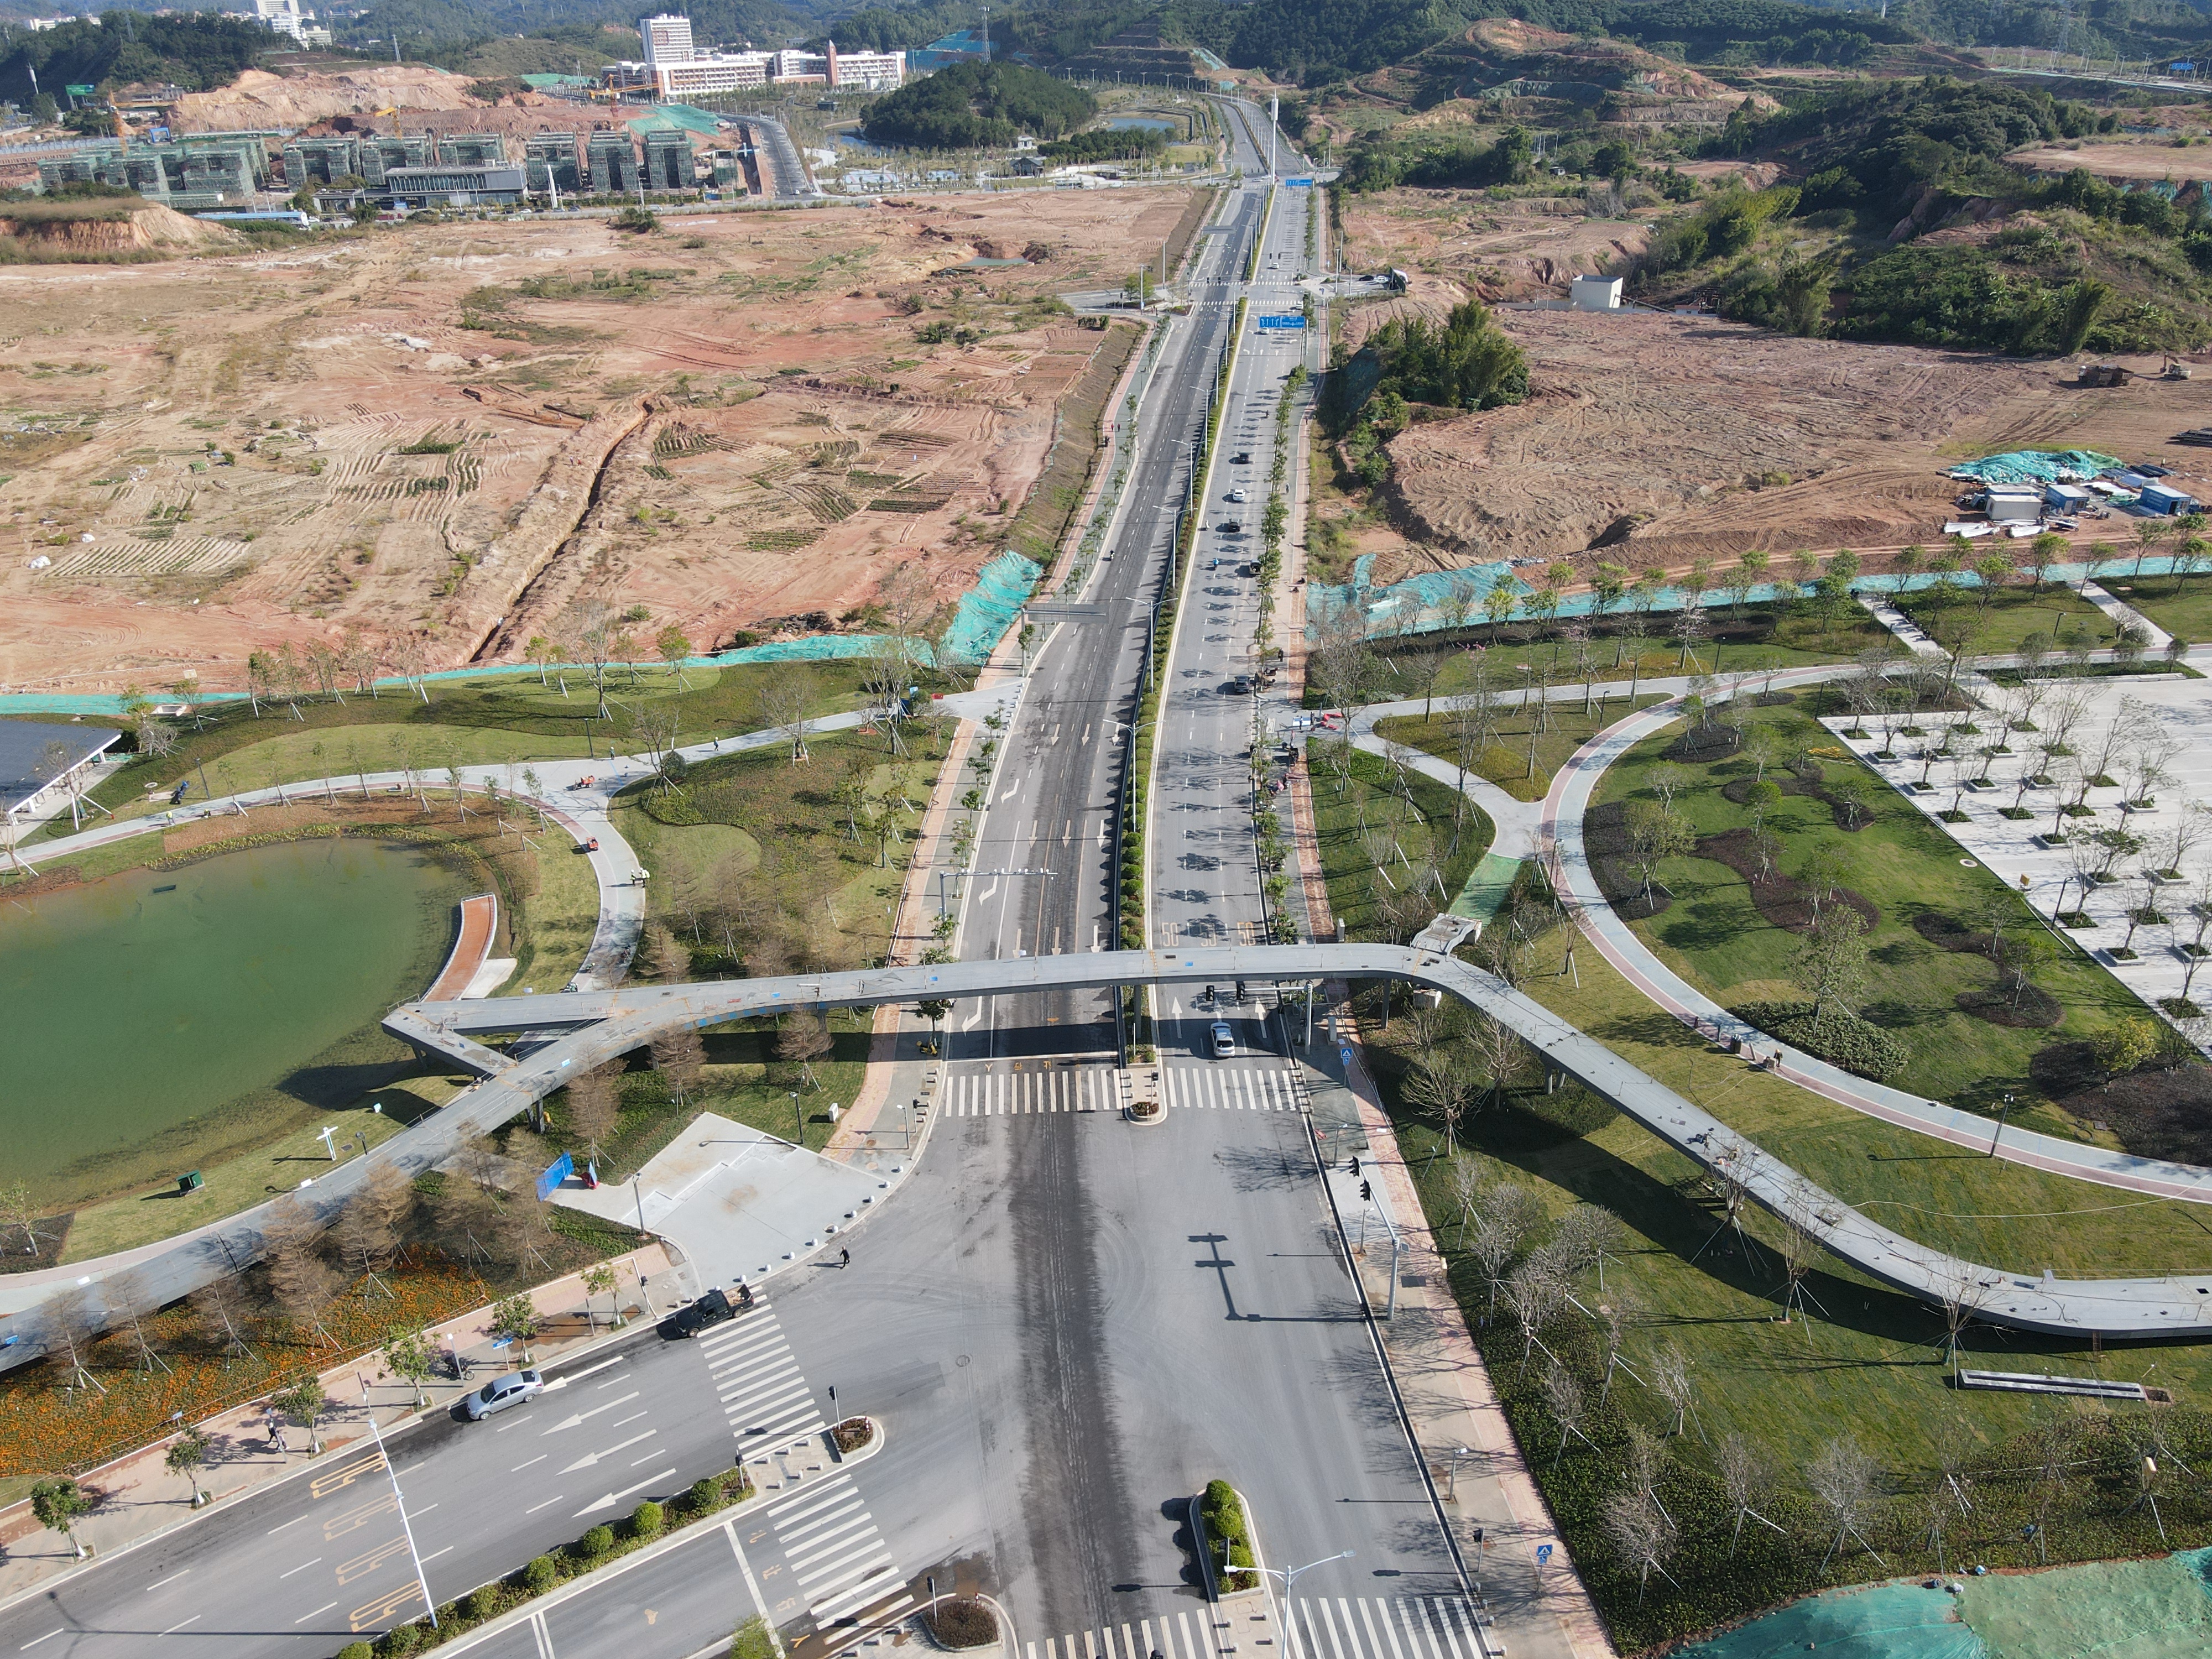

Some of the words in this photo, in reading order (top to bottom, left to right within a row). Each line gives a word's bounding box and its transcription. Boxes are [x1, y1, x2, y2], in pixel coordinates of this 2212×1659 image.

[1162, 922, 1179, 947] 50
[1237, 922, 1256, 946] 50
[310, 1451, 388, 1499] 50
[323, 1492, 399, 1541] 50
[335, 1534, 412, 1586] 50
[349, 1579, 425, 1632] 50
